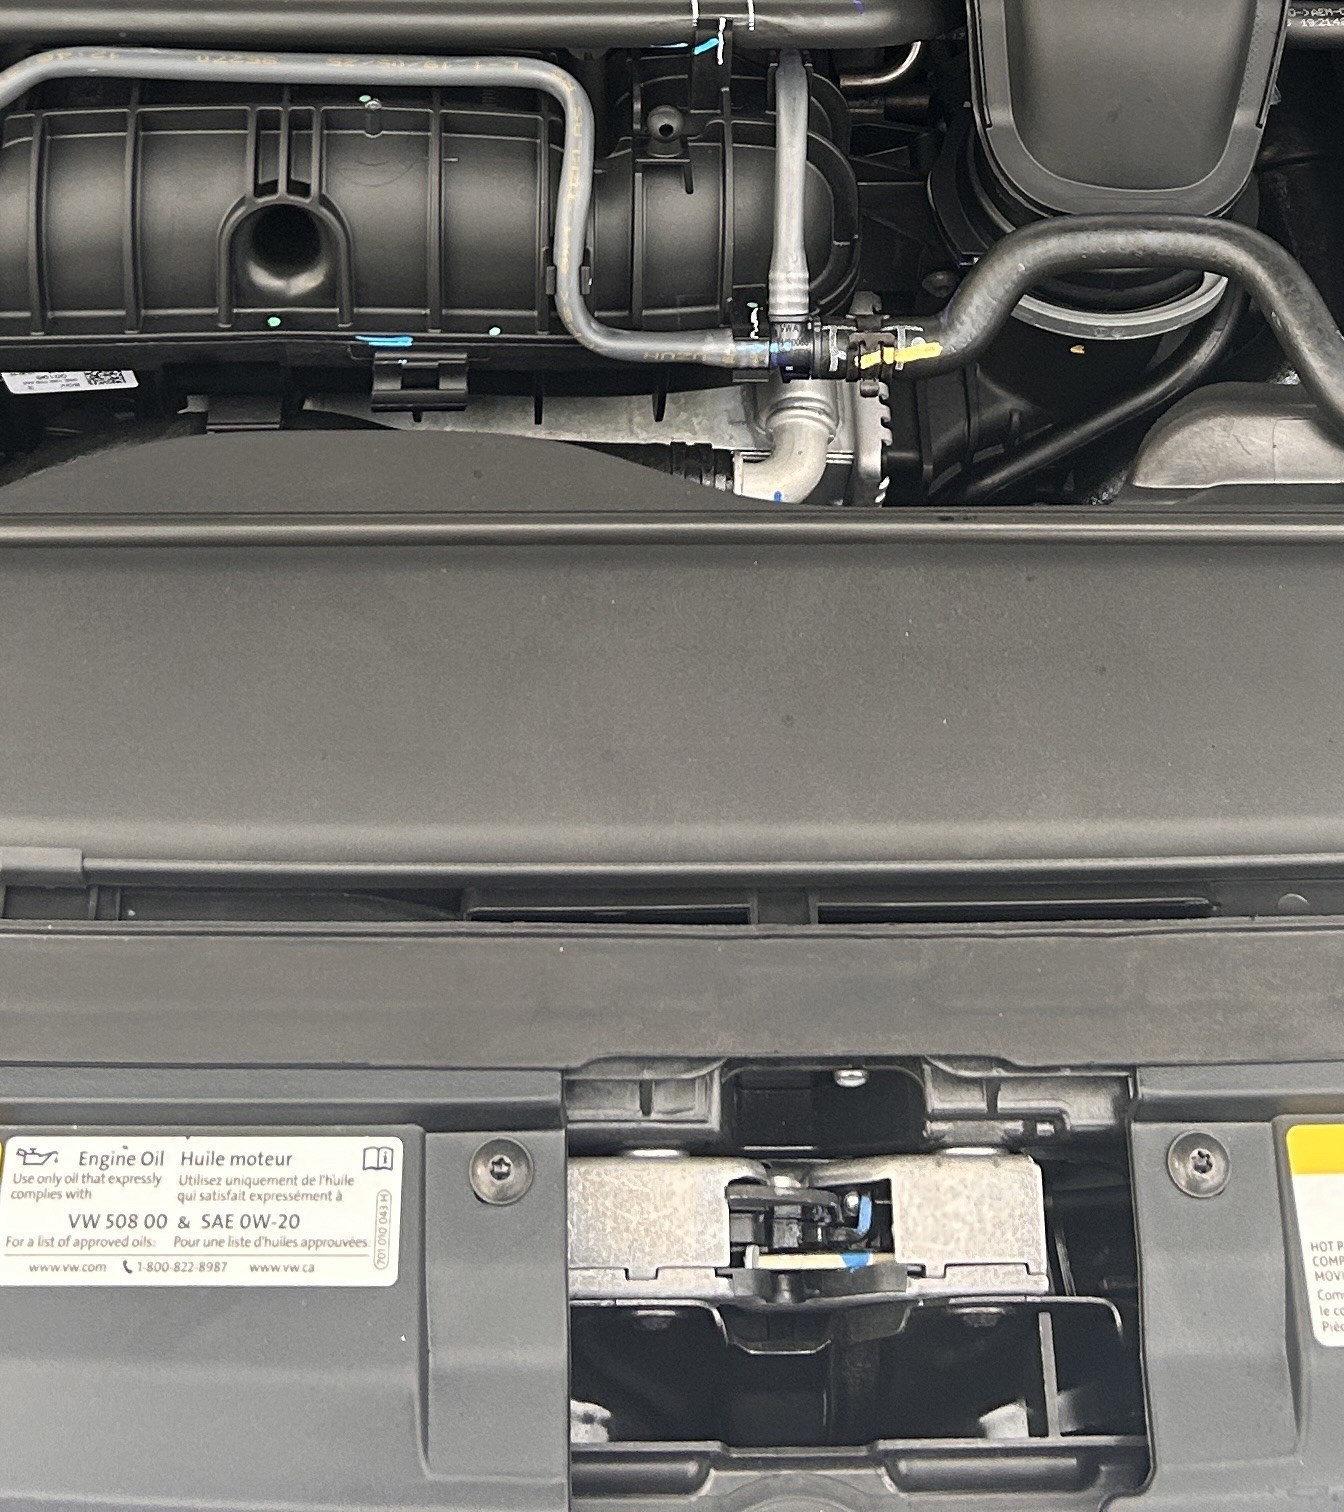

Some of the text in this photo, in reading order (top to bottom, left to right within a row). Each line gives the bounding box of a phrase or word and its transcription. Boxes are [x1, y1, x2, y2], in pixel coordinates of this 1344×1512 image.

[78, 1150, 293, 1171] Engine Oil Huile moteur
[12, 1171, 163, 1188] Use only oil that expressly
[178, 1173, 355, 1189] Utilisez uniquement de l'huile
[10, 1187, 92, 1203] complies with
[176, 1189, 196, 1205] qui
[198, 1188, 247, 1202] satisfait
[248, 1189, 332, 1205] expressément
[379, 1193, 388, 1202] H
[68, 1213, 300, 1230] VW 508 00 & SAE 0W-20
[378, 1205, 388, 1224] 043
[5, 1235, 24, 1248] For
[26, 1237, 35, 1248] a
[37, 1235, 55, 1248] list
[57, 1235, 72, 1248] of
[72, 1235, 130, 1251] approved
[173, 1235, 201, 1248] Pour
[202, 1238, 226, 1248] une
[227, 1235, 252, 1248] liste
[253, 1234, 299, 1248] d'huiles
[1309, 1240, 1334, 1252] HOT
[377, 1249, 385, 1264] 701
[28, 1260, 315, 1273] www.vw.com 1-800-822-8987 www.vw.ca
[1319, 1304, 1330, 1317] le
